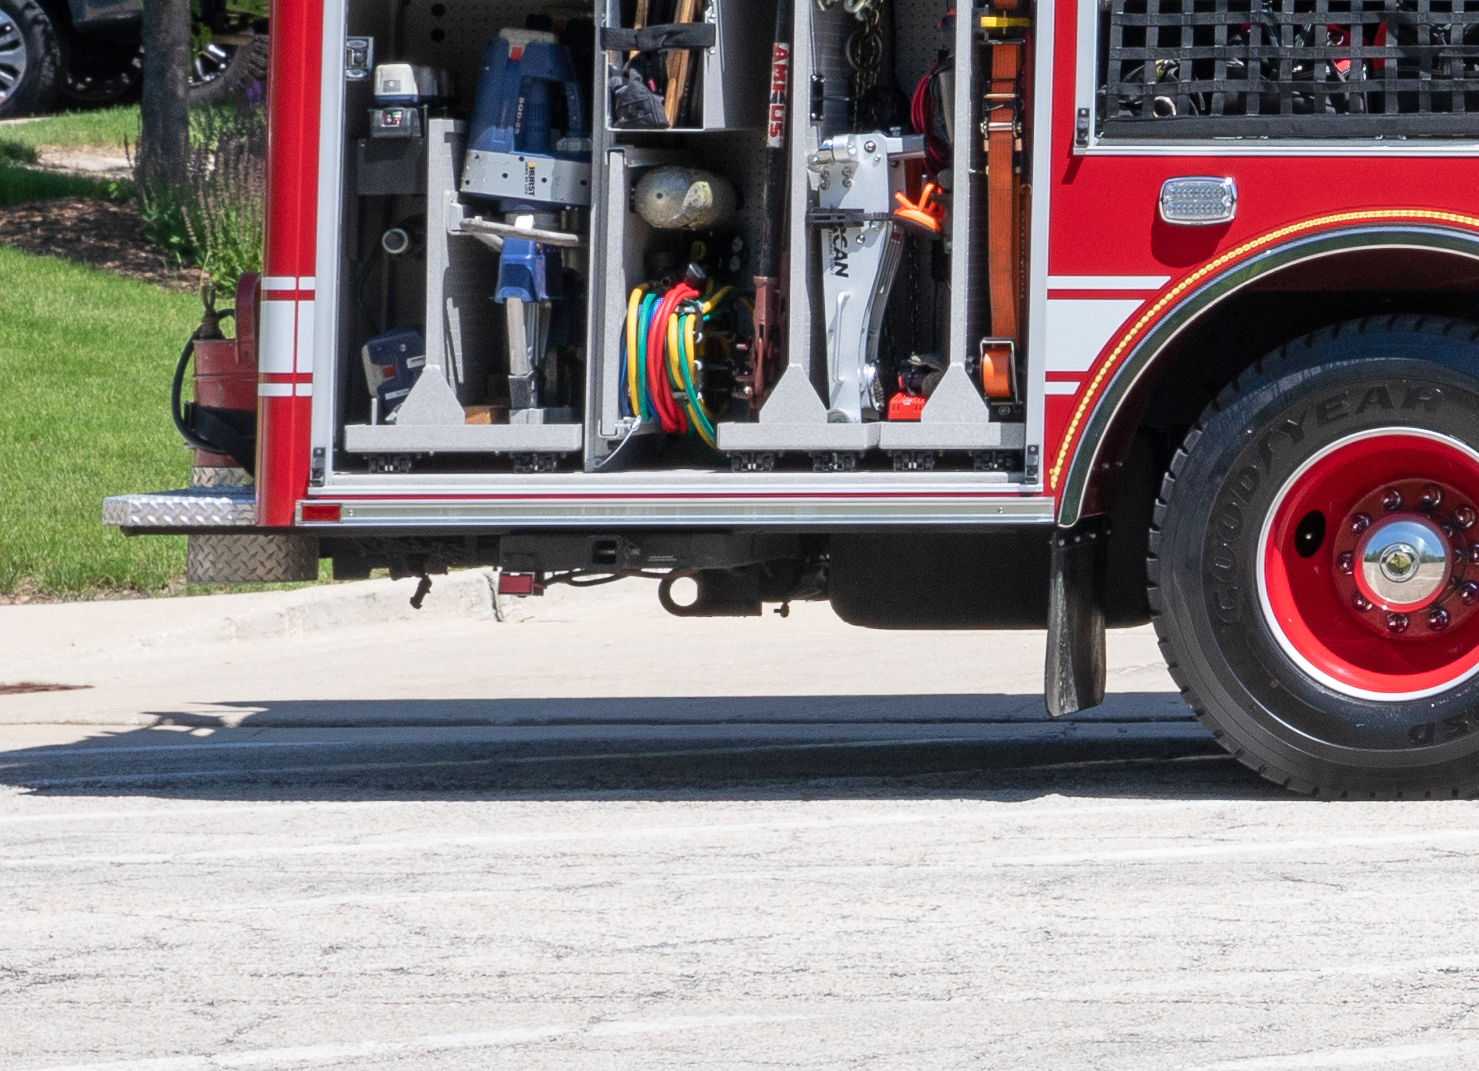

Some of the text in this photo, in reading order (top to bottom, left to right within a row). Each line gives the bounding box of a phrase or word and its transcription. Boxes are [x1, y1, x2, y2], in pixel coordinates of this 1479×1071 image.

[527, 166, 537, 197] HURST
[831, 225, 849, 278] RCAN
[1212, 383, 1445, 625] GOODYEAR
